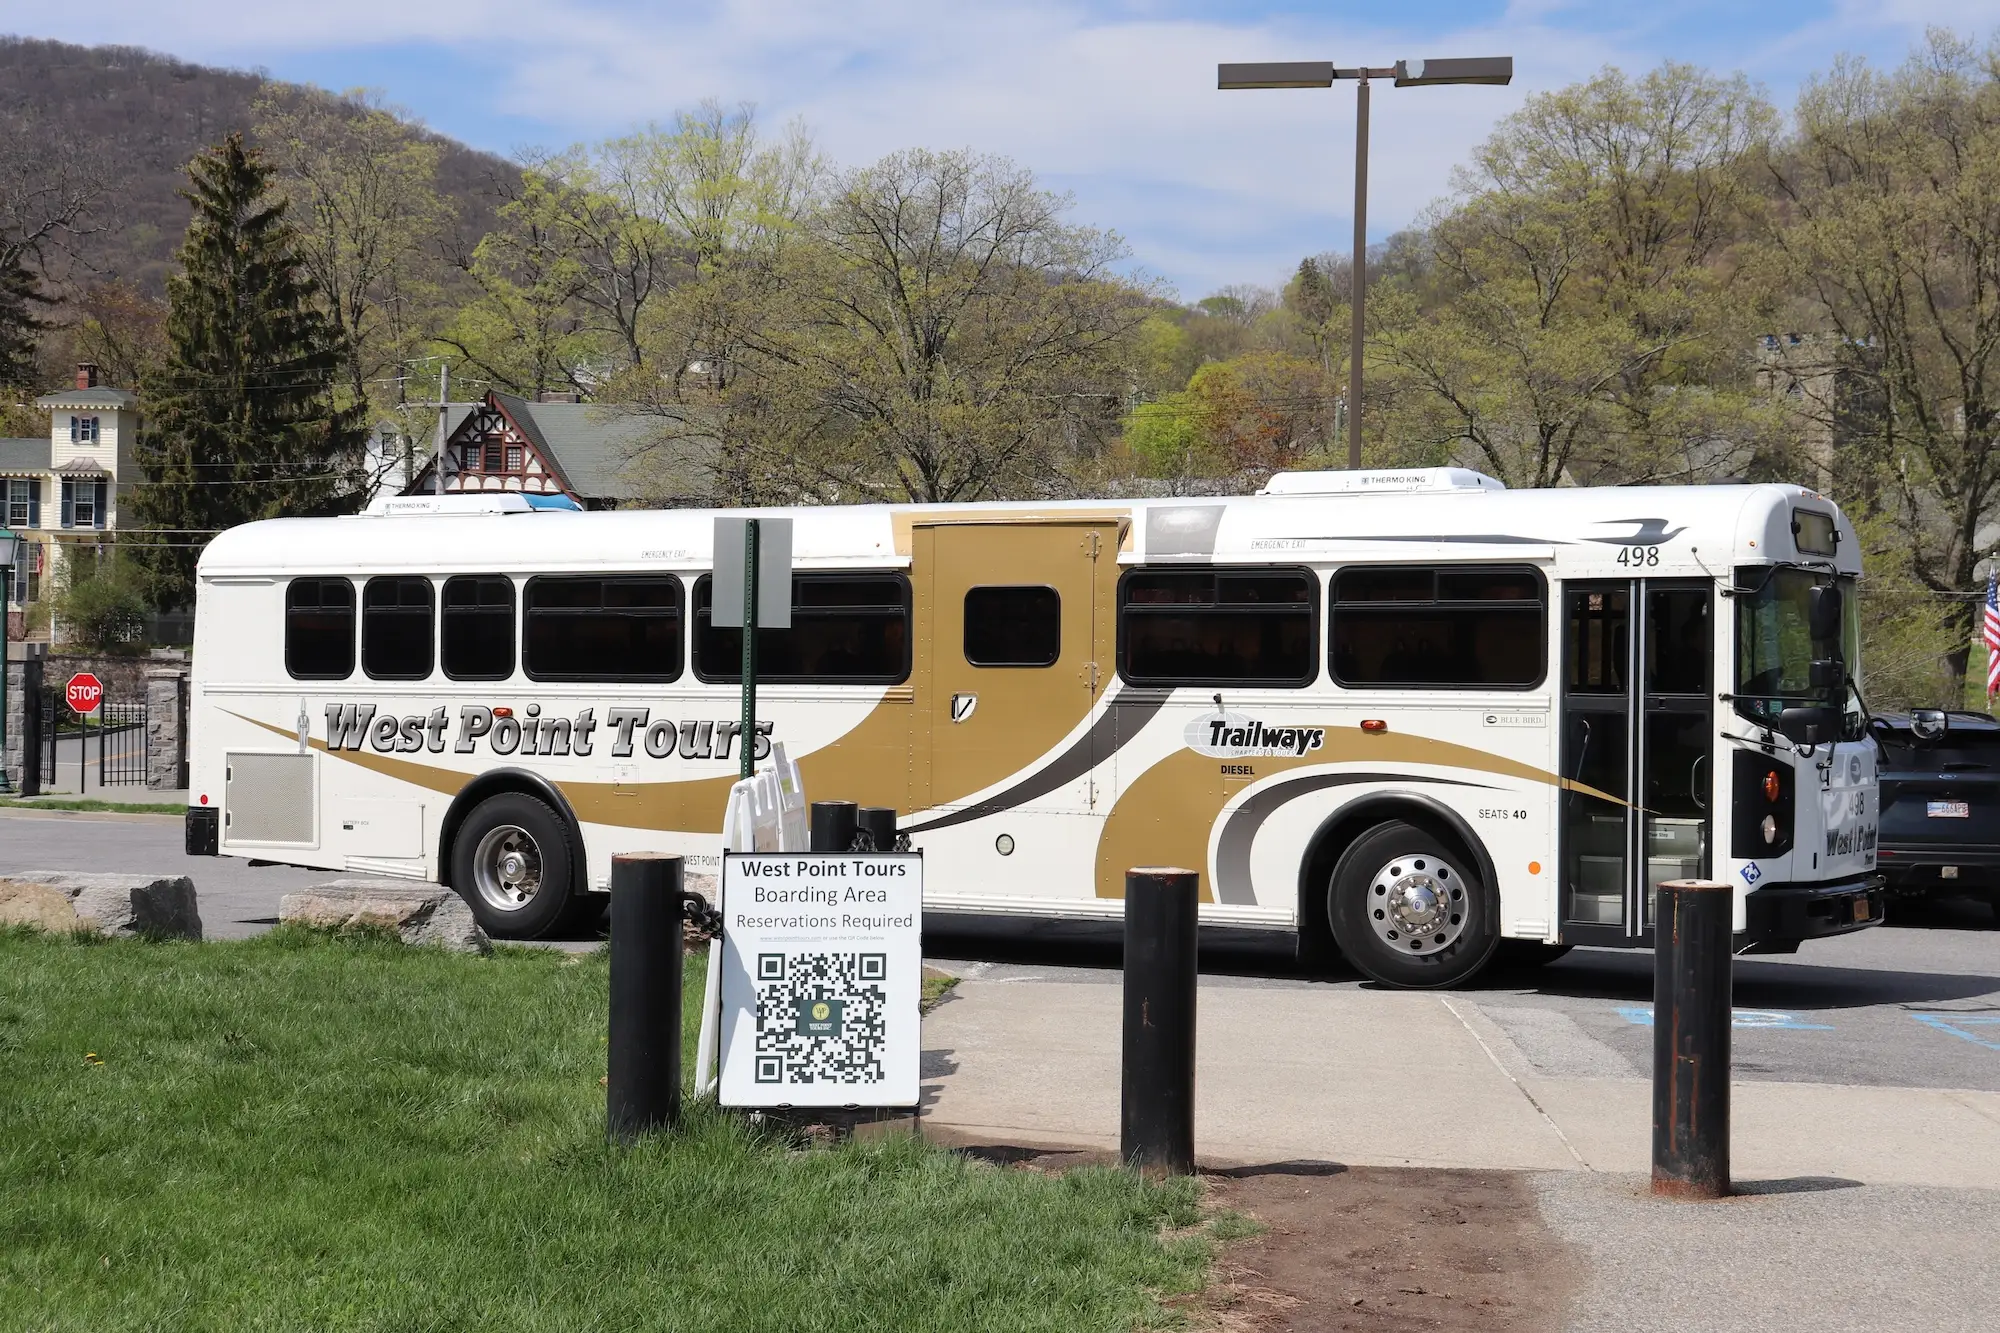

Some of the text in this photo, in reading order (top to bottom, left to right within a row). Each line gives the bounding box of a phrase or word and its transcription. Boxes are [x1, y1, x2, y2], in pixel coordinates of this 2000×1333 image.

[1251, 539, 1306, 549] EMERGENCY EXIT
[1616, 546, 1660, 567] 498
[69, 685, 100, 700] STOP
[1500, 716, 1520, 724] BLUE
[325, 703, 774, 760] West Point Tours
[1210, 720, 1324, 756] Trailways
[1221, 765, 1255, 775] DIESEL
[1848, 792, 1864, 816] 498
[1478, 808, 1527, 820] SEATS 40
[1826, 827, 1854, 857] West
[684, 855, 720, 866] WEST POINT
[741, 860, 906, 877] West Point Tours
[755, 886, 887, 907] Boarding Area
[737, 913, 913, 931] Reservations Required
